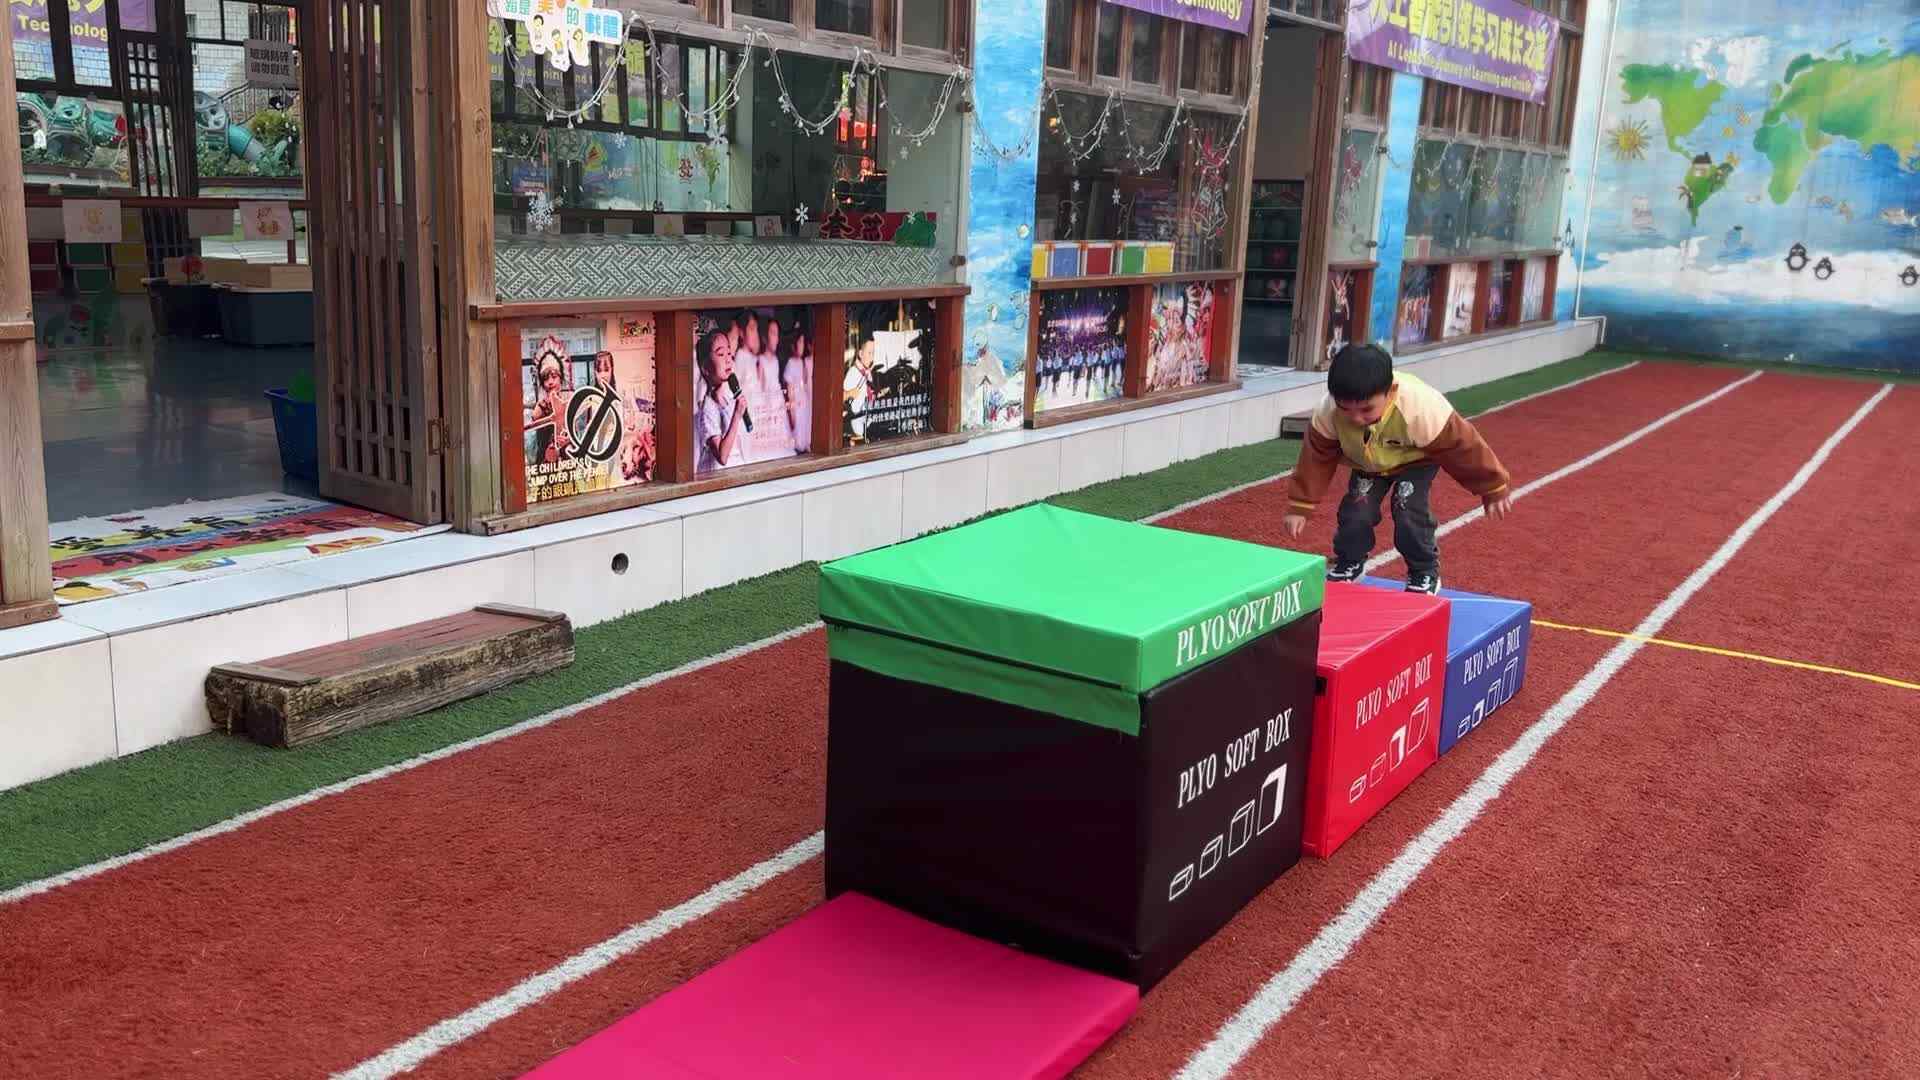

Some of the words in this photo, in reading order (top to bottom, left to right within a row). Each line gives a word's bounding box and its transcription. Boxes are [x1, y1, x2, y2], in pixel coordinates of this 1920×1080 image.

[549, 471, 568, 484] OVER
[1176, 615, 1225, 667] PLYO
[1227, 596, 1273, 644] SOFT
[1271, 580, 1304, 624] BOX
[1463, 650, 1484, 684] PLYO
[1486, 637, 1505, 670] SOFT
[1506, 625, 1522, 656] BOX
[1355, 686, 1382, 729] PLYO
[1386, 667, 1412, 707] SOFT
[1414, 653, 1433, 689] BOX
[1177, 753, 1217, 809] PLYO
[1224, 728, 1260, 778] SOFT
[1265, 707, 1293, 753] BOX
